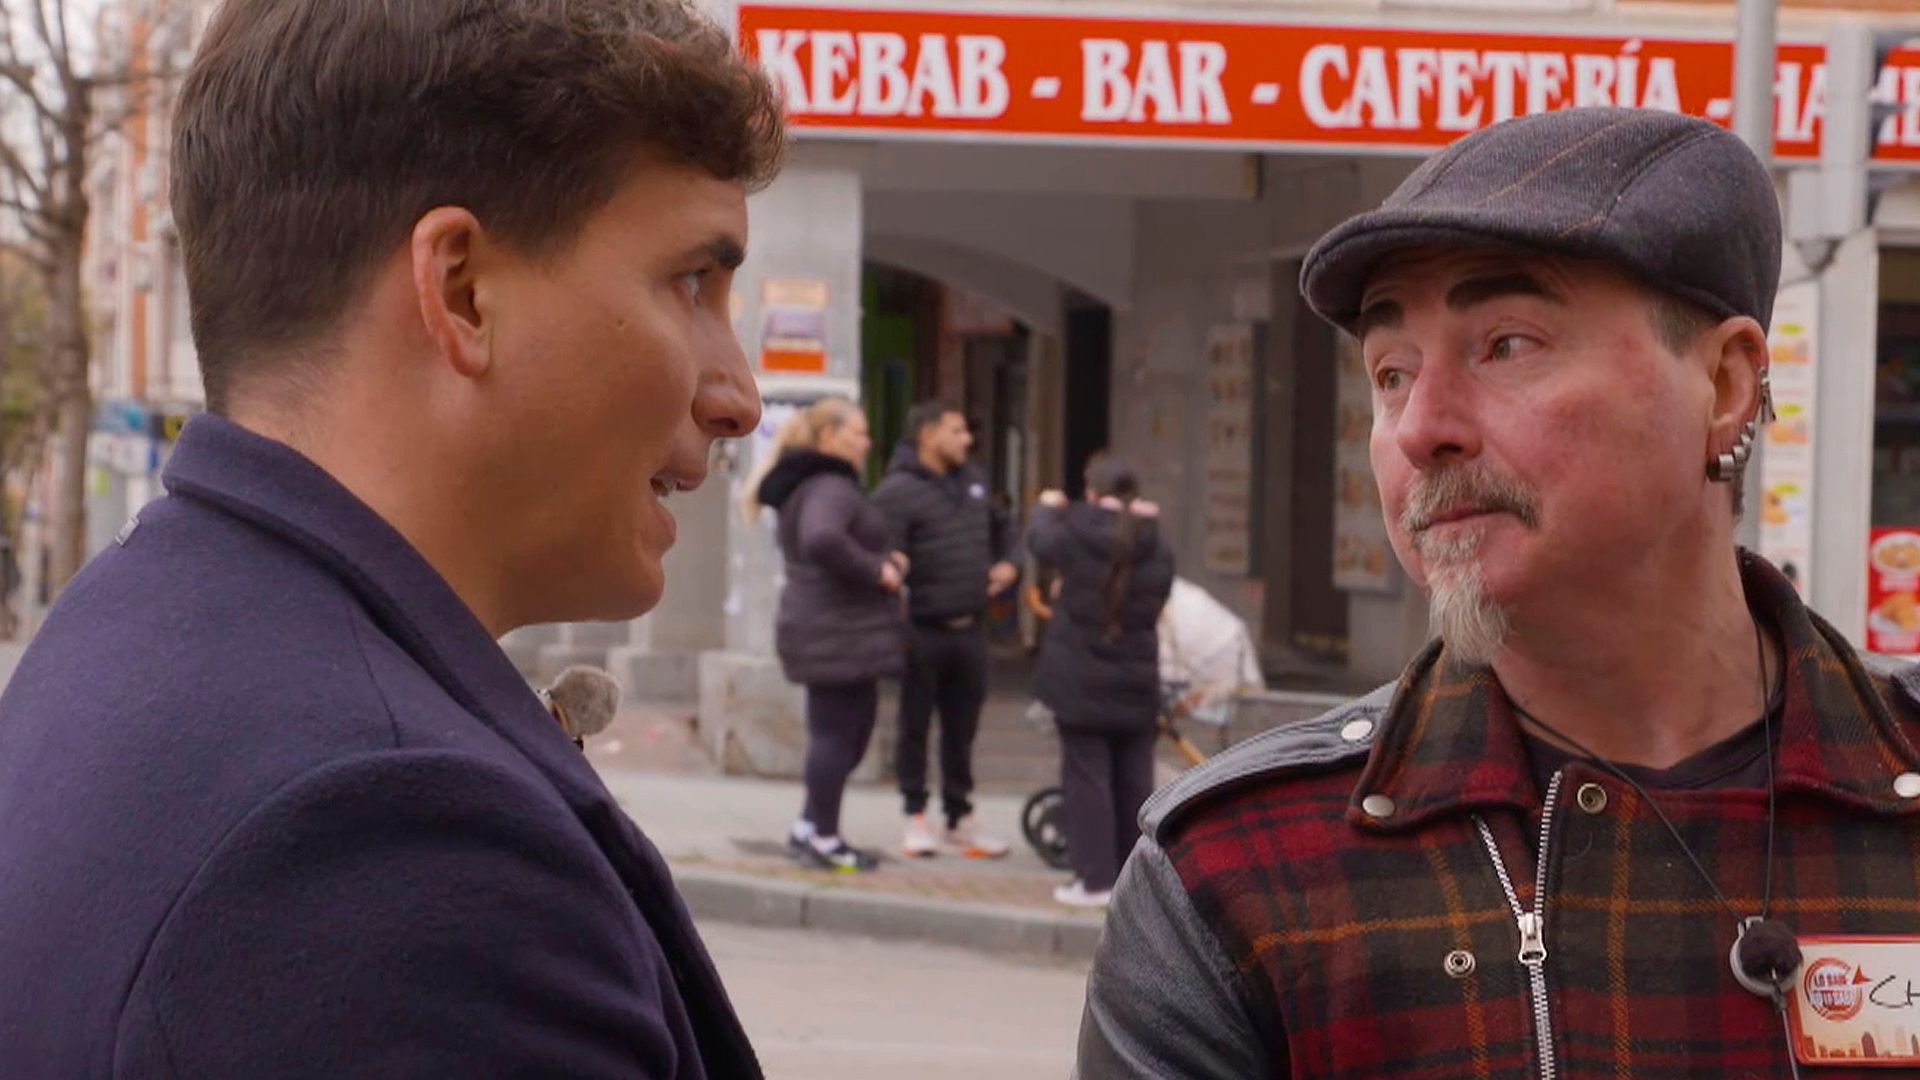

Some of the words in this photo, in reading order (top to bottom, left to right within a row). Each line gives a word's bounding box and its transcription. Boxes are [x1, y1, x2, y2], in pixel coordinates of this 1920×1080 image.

[756, 29, 1009, 118] KEBAB
[1081, 39, 1231, 123] BAR
[1300, 39, 1682, 130] CAFETERÍA
